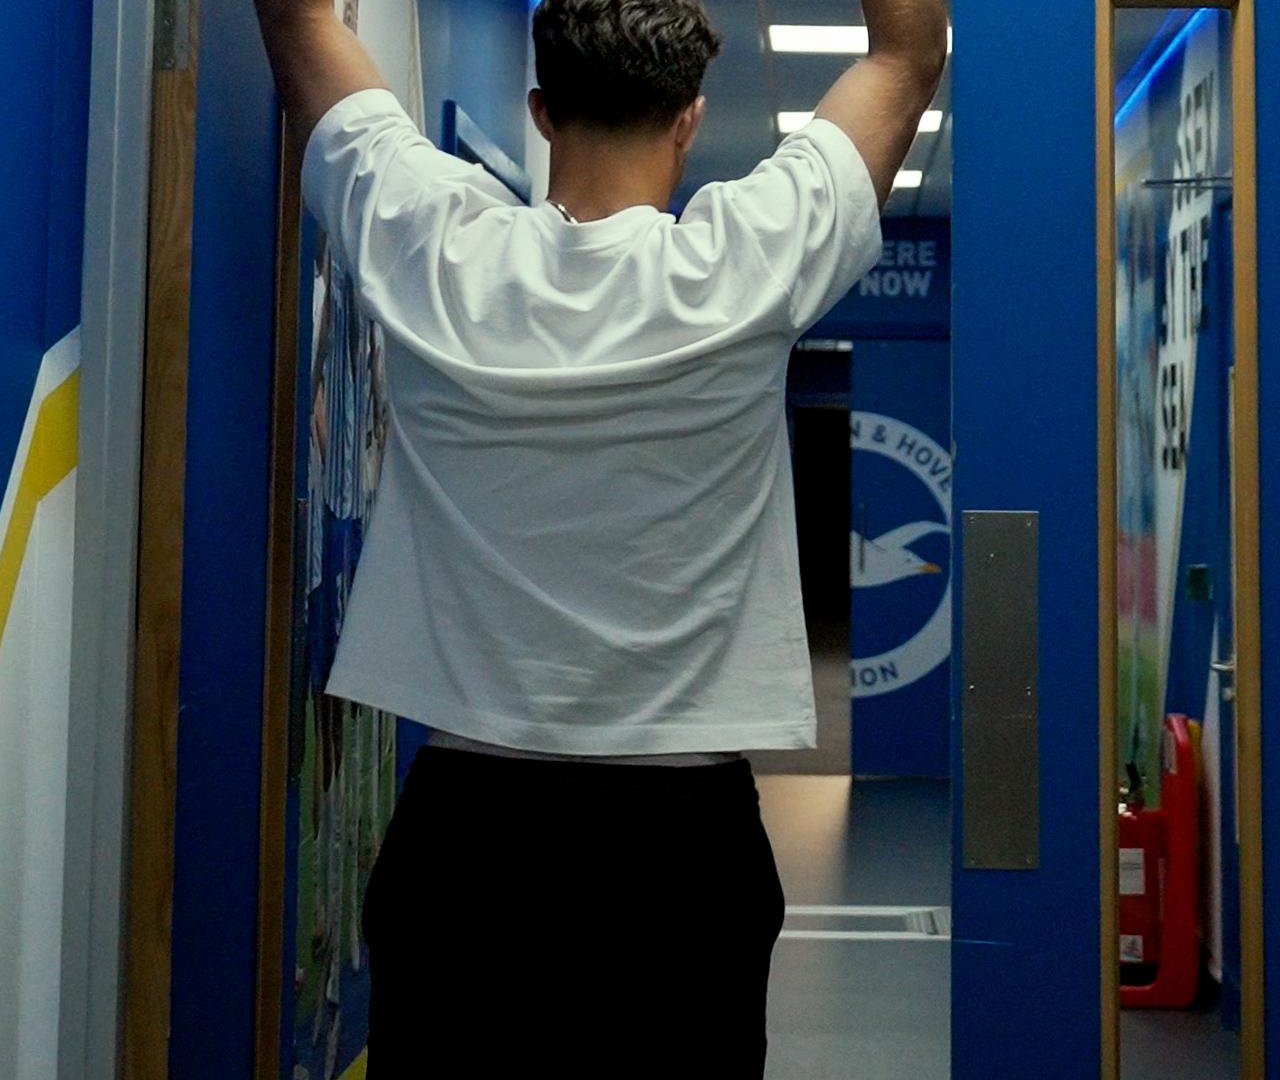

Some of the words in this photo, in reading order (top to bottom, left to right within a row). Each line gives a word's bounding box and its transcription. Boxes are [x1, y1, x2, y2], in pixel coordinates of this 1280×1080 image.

[880, 240, 937, 267] ERE
[860, 269, 933, 297] NOW
[1161, 361, 1187, 470] SEA
[871, 424, 888, 445] &
[850, 661, 899, 689] ION
